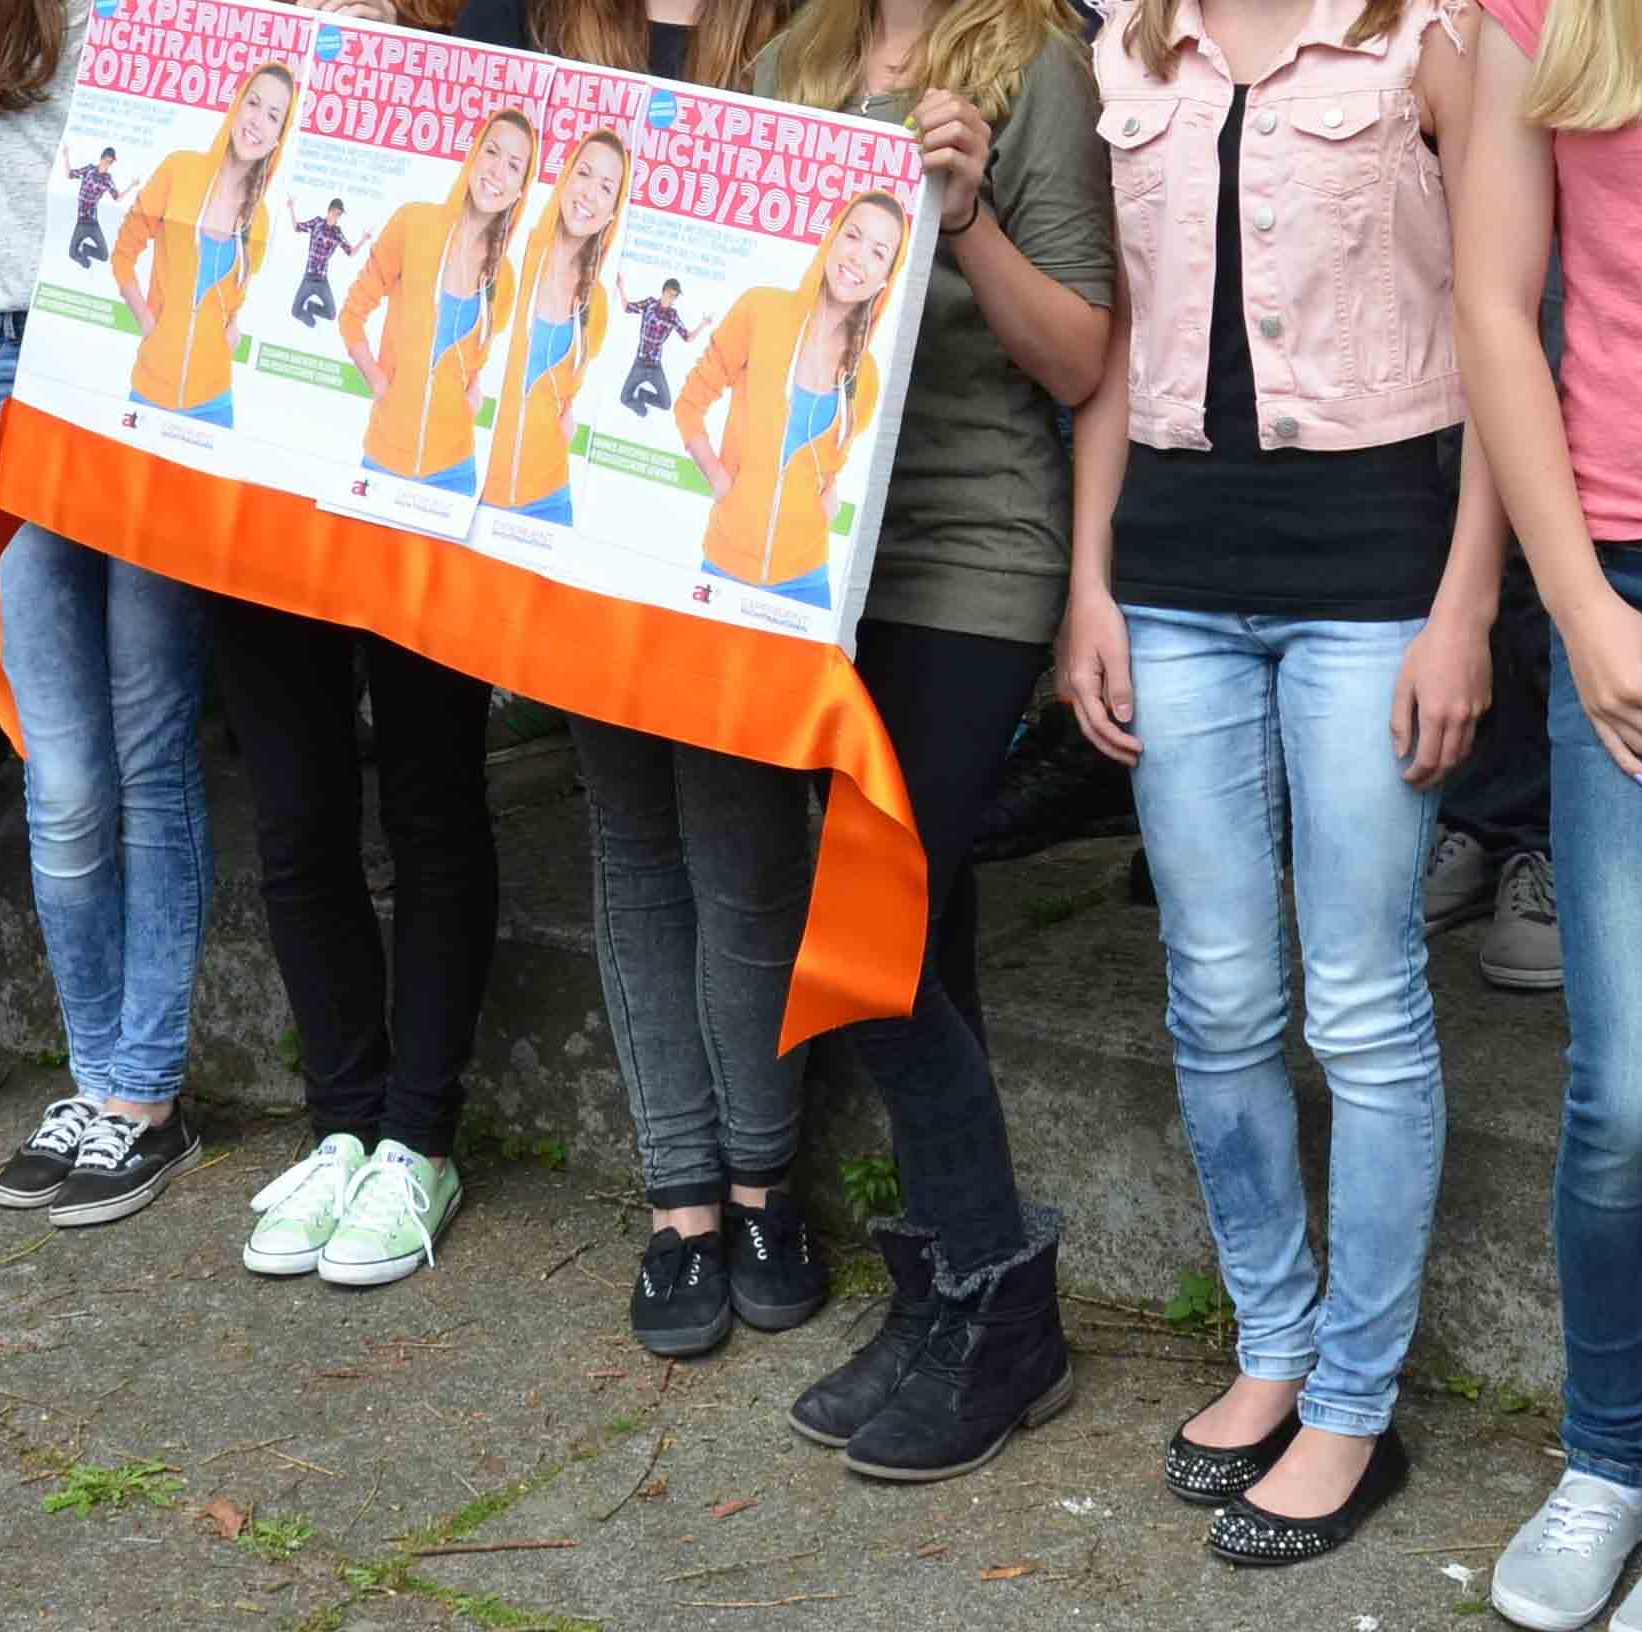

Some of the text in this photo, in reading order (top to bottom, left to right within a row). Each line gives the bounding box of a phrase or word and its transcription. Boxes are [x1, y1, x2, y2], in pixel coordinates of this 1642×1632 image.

[76, 44, 237, 105] 2013/2014
[338, 32, 555, 97] EXPERIMENT
[299, 89, 474, 154] 2013/2014
[674, 96, 923, 180] EXPERIMENT
[630, 158, 833, 237] 2013/2014
